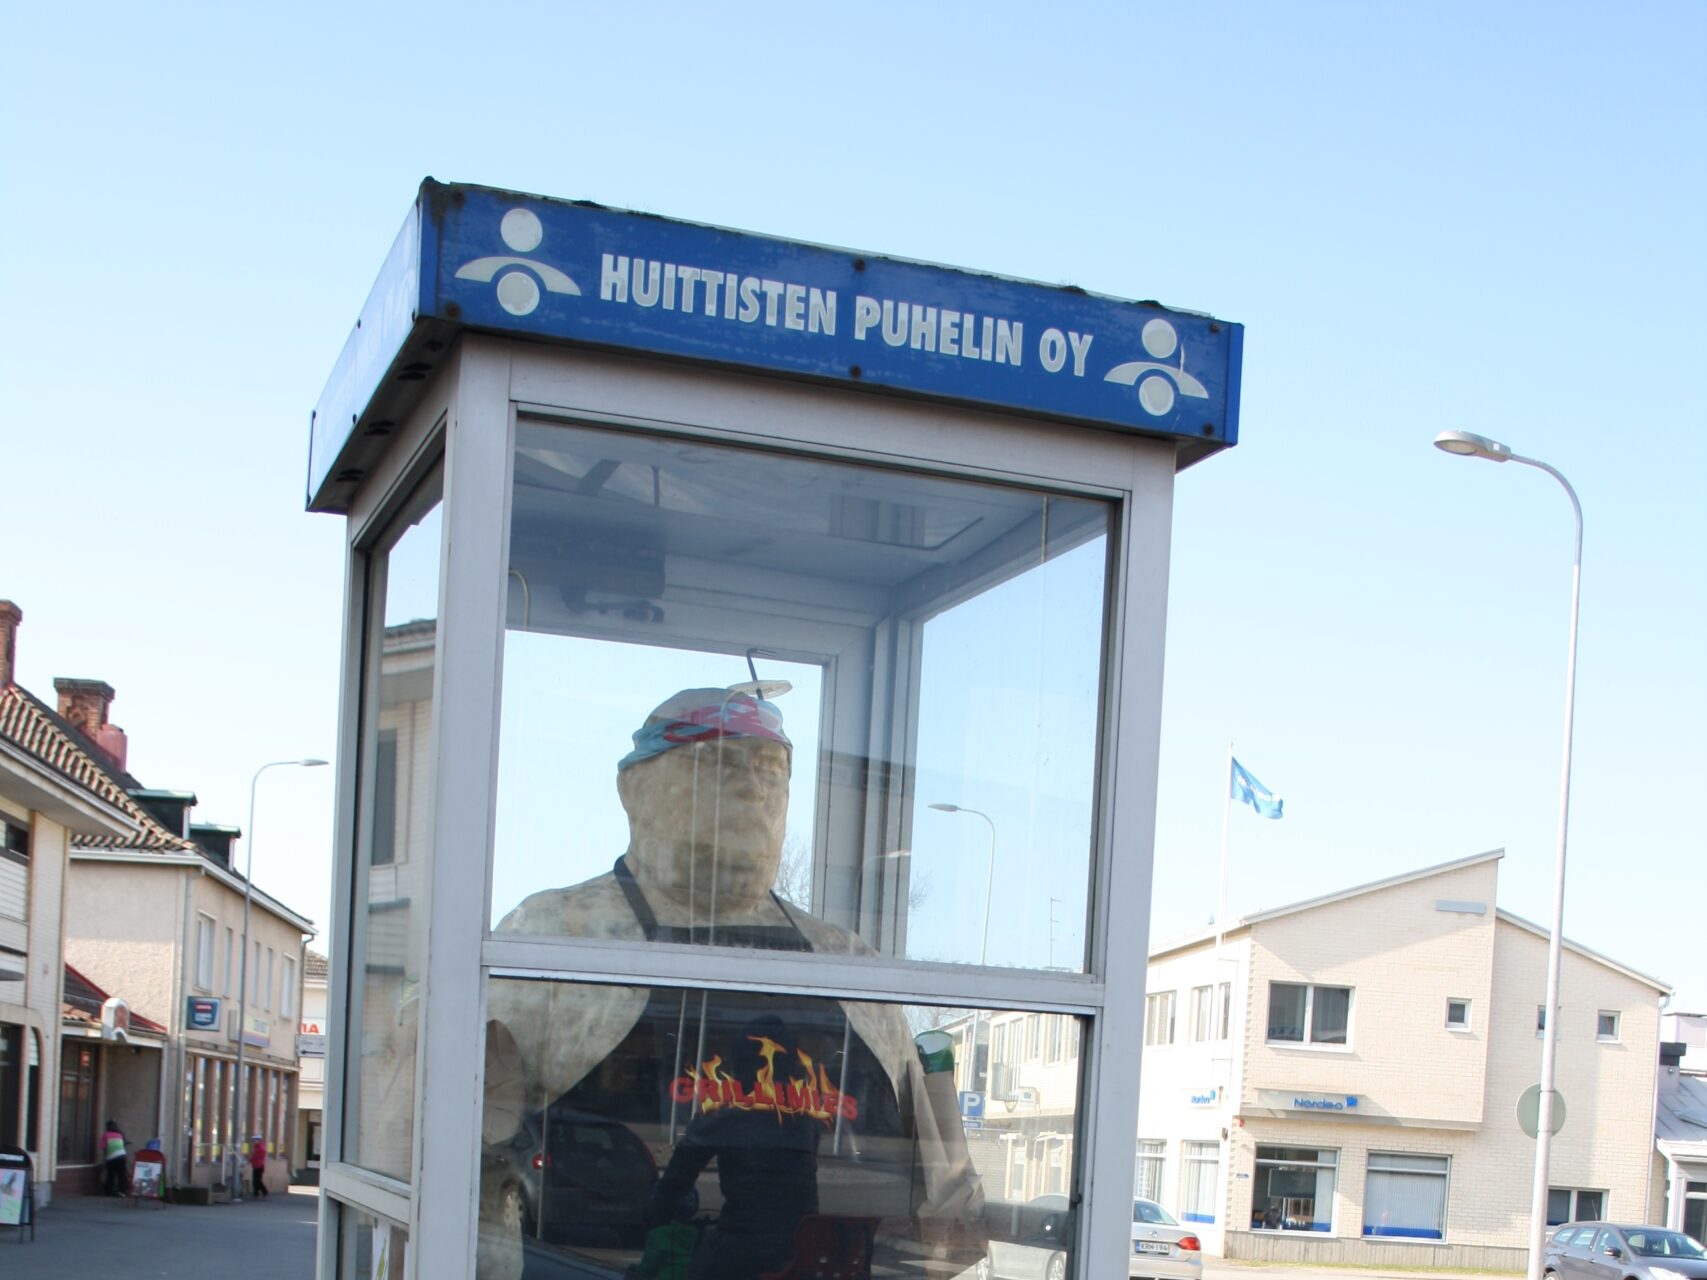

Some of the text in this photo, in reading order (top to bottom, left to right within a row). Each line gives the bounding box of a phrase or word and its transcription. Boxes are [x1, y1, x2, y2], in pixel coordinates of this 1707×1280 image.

[600, 253, 1094, 378] HUITTISTEN PUHELIN OY
[963, 1093, 980, 1115] P
[1293, 1097, 1344, 1111] Nordea
